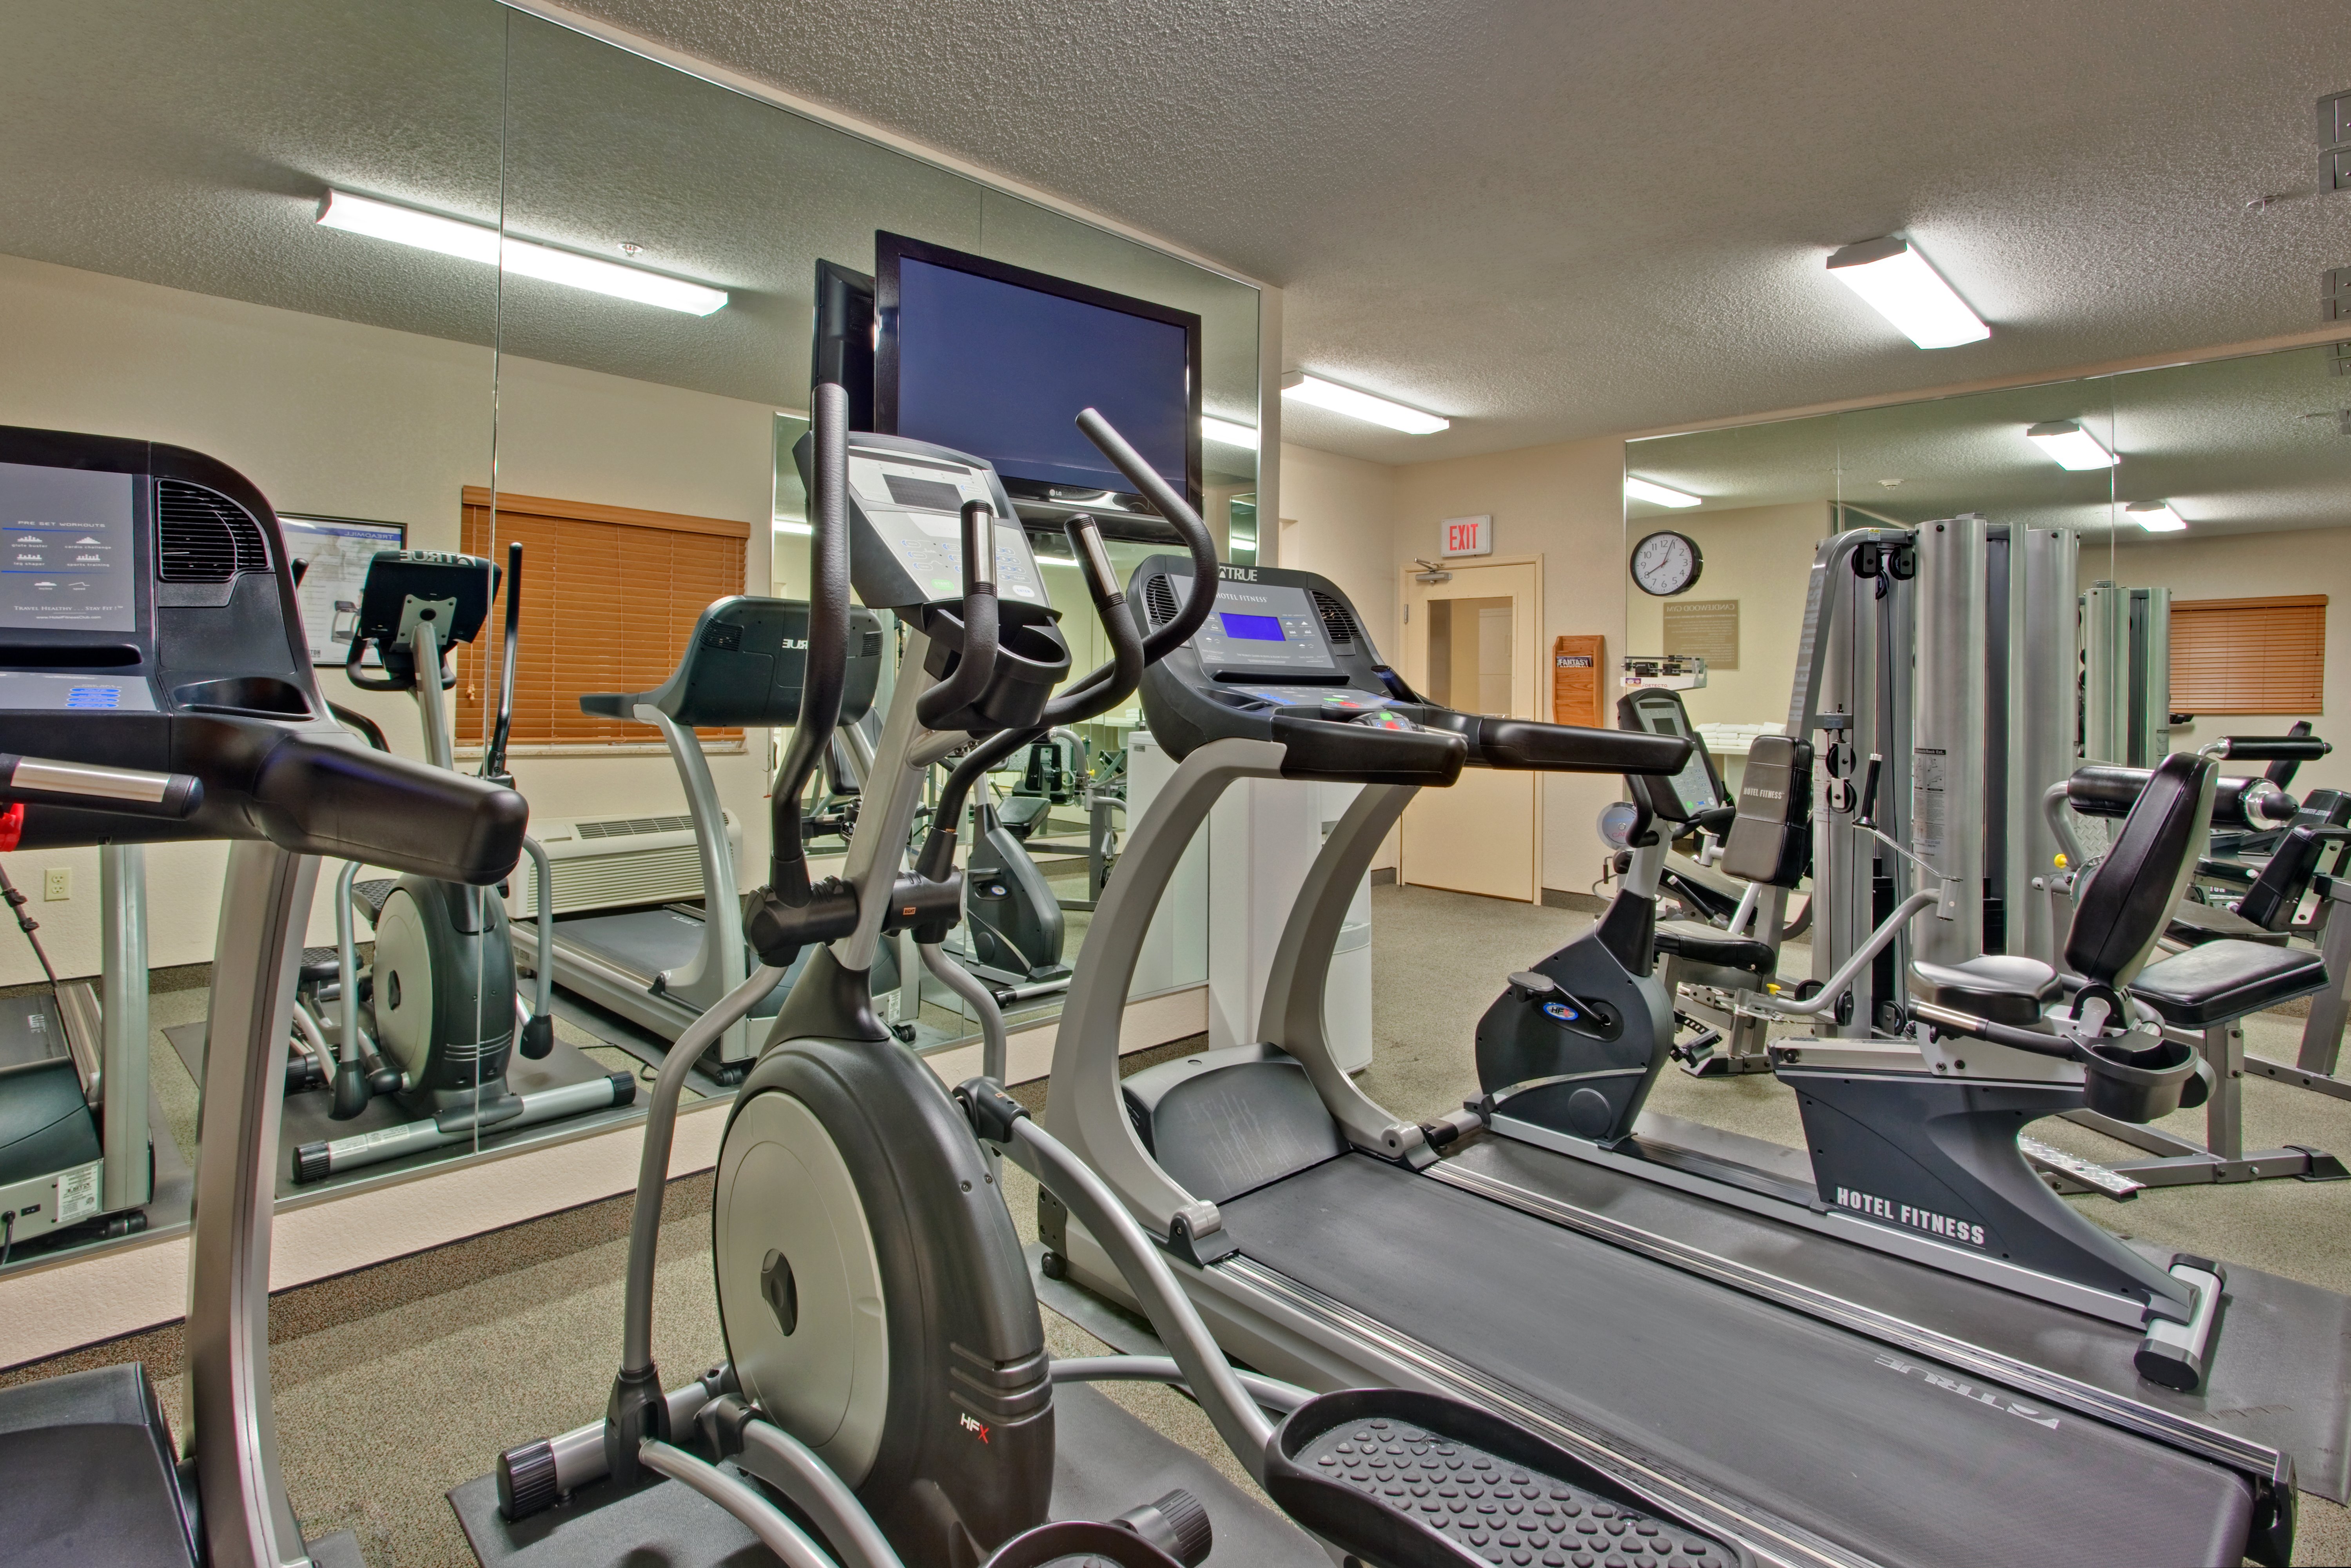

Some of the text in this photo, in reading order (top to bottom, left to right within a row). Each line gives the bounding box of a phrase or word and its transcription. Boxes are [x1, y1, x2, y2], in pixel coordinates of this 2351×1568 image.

[1449, 523, 1478, 551] EXIT
[1226, 567, 1257, 582] TRUE
[1216, 592, 1238, 601] HOTEL
[1788, 574, 1824, 721] HOTEL FITNESS
[1743, 787, 1758, 797] HOTEL
[1837, 1187, 1985, 1245] HOTEL FITNESS
[1874, 1354, 2005, 1410] TRUE
[960, 1412, 989, 1444] HFX
